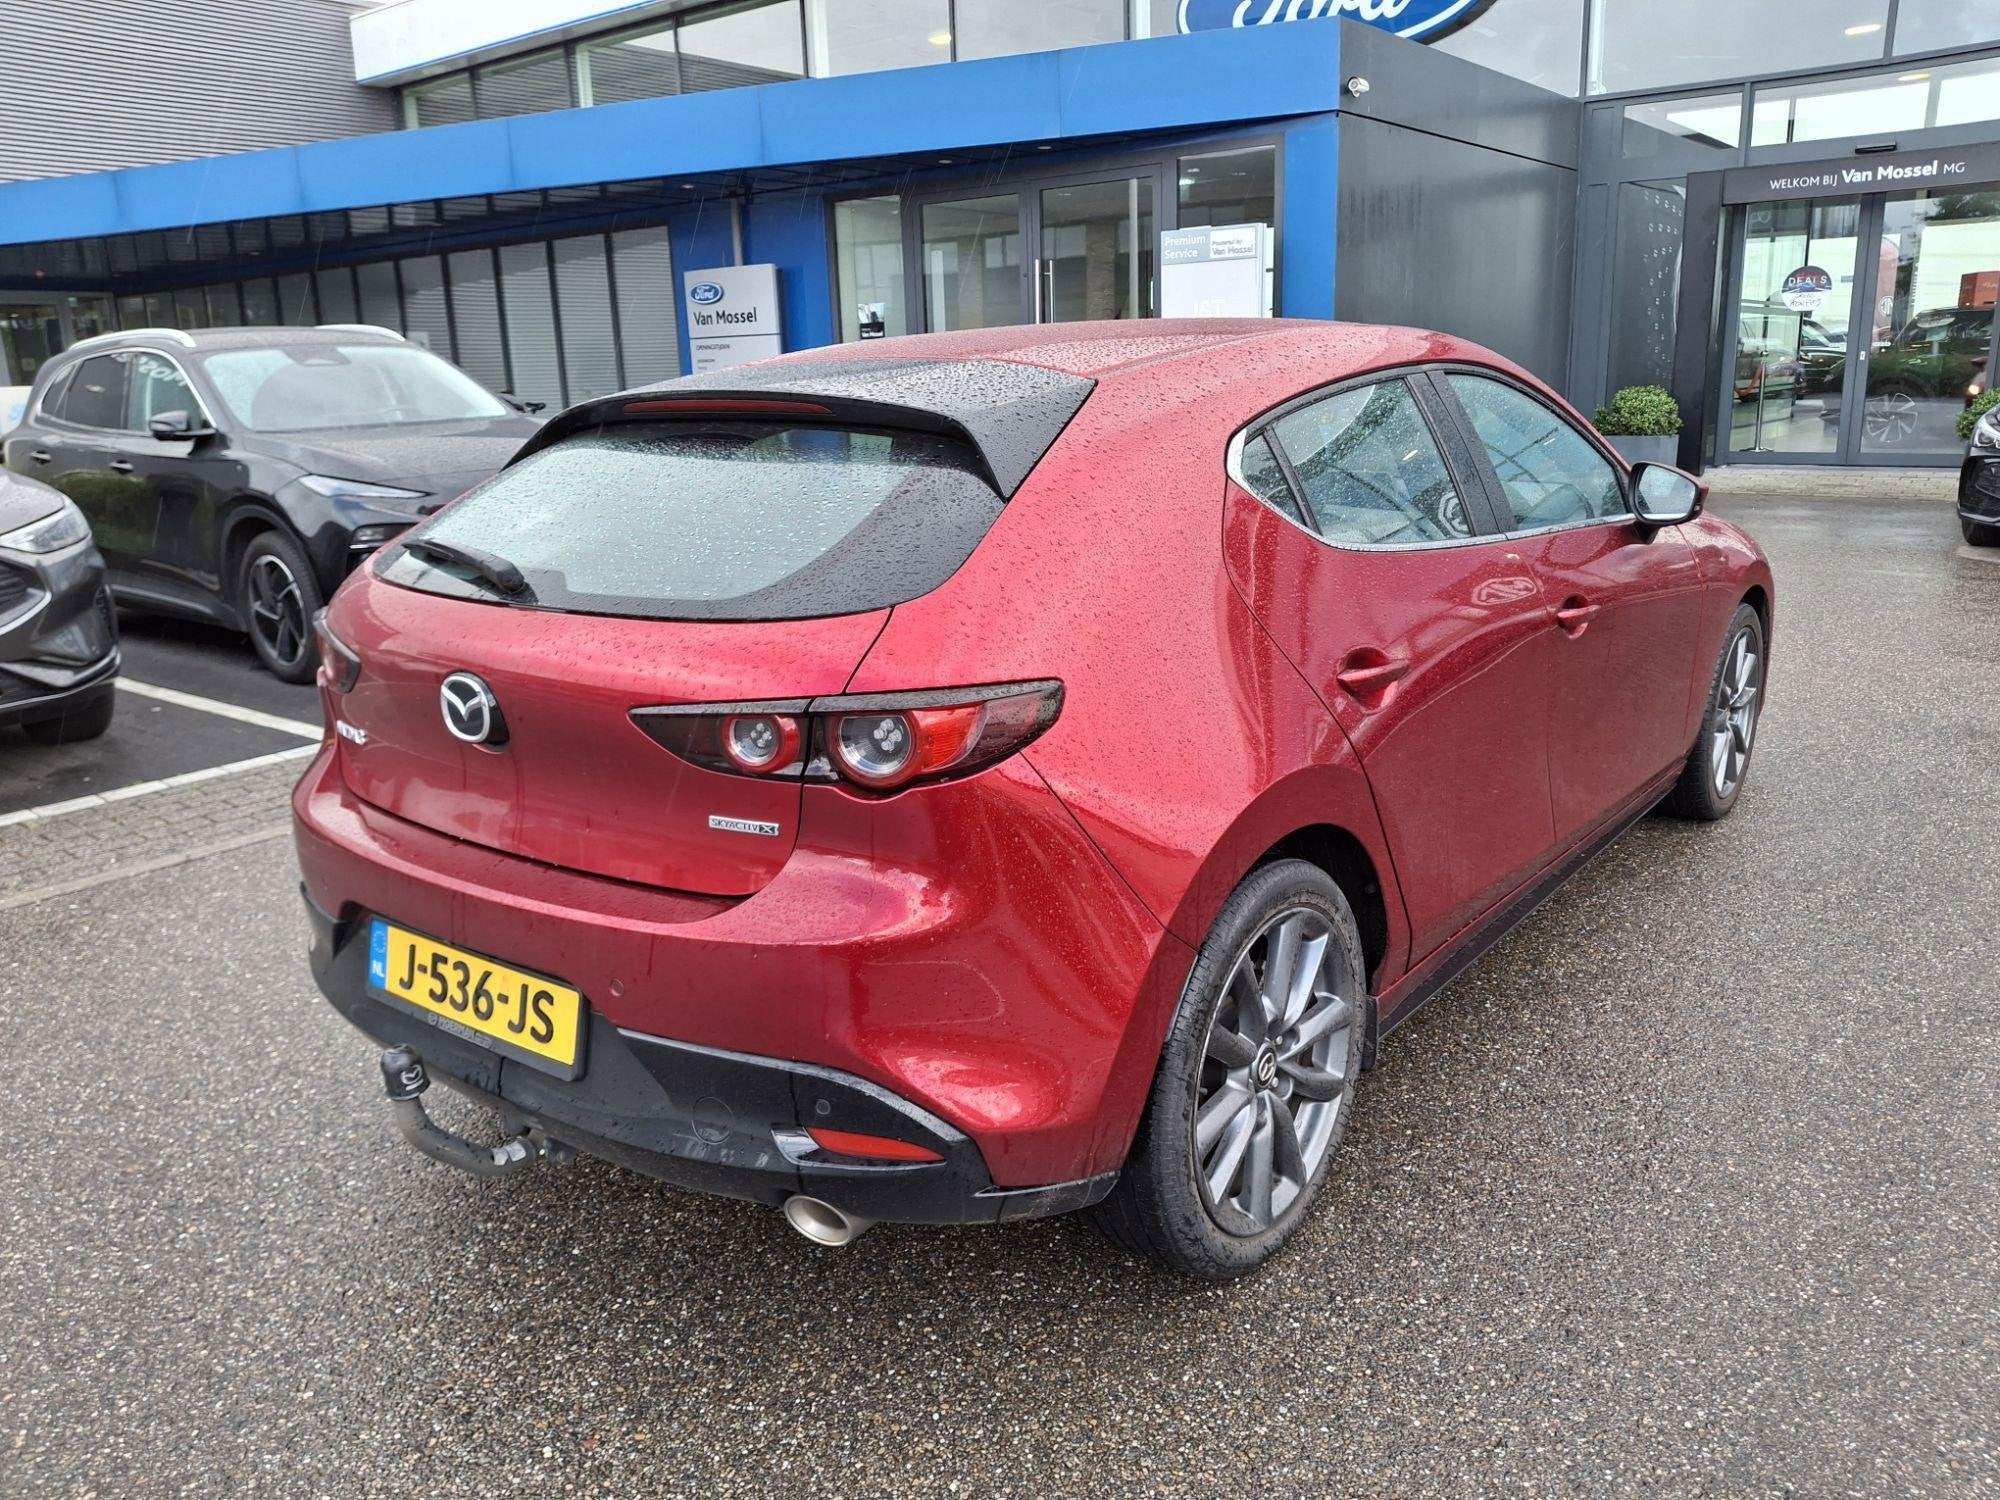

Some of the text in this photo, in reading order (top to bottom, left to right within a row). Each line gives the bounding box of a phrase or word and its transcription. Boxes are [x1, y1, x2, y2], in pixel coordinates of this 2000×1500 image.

[1769, 160, 1966, 190] WELKOM BIJ Van Mossel MG
[1164, 235, 1206, 247] Premium
[1164, 248, 1199, 260] Service
[1211, 244, 1254, 256] Van Mossel
[694, 285, 716, 301] Ford
[693, 306, 758, 326] Van Mossel
[711, 818, 758, 832] SKYACTIV
[371, 959, 385, 978] NL
[398, 944, 554, 1044] J-536-JS
